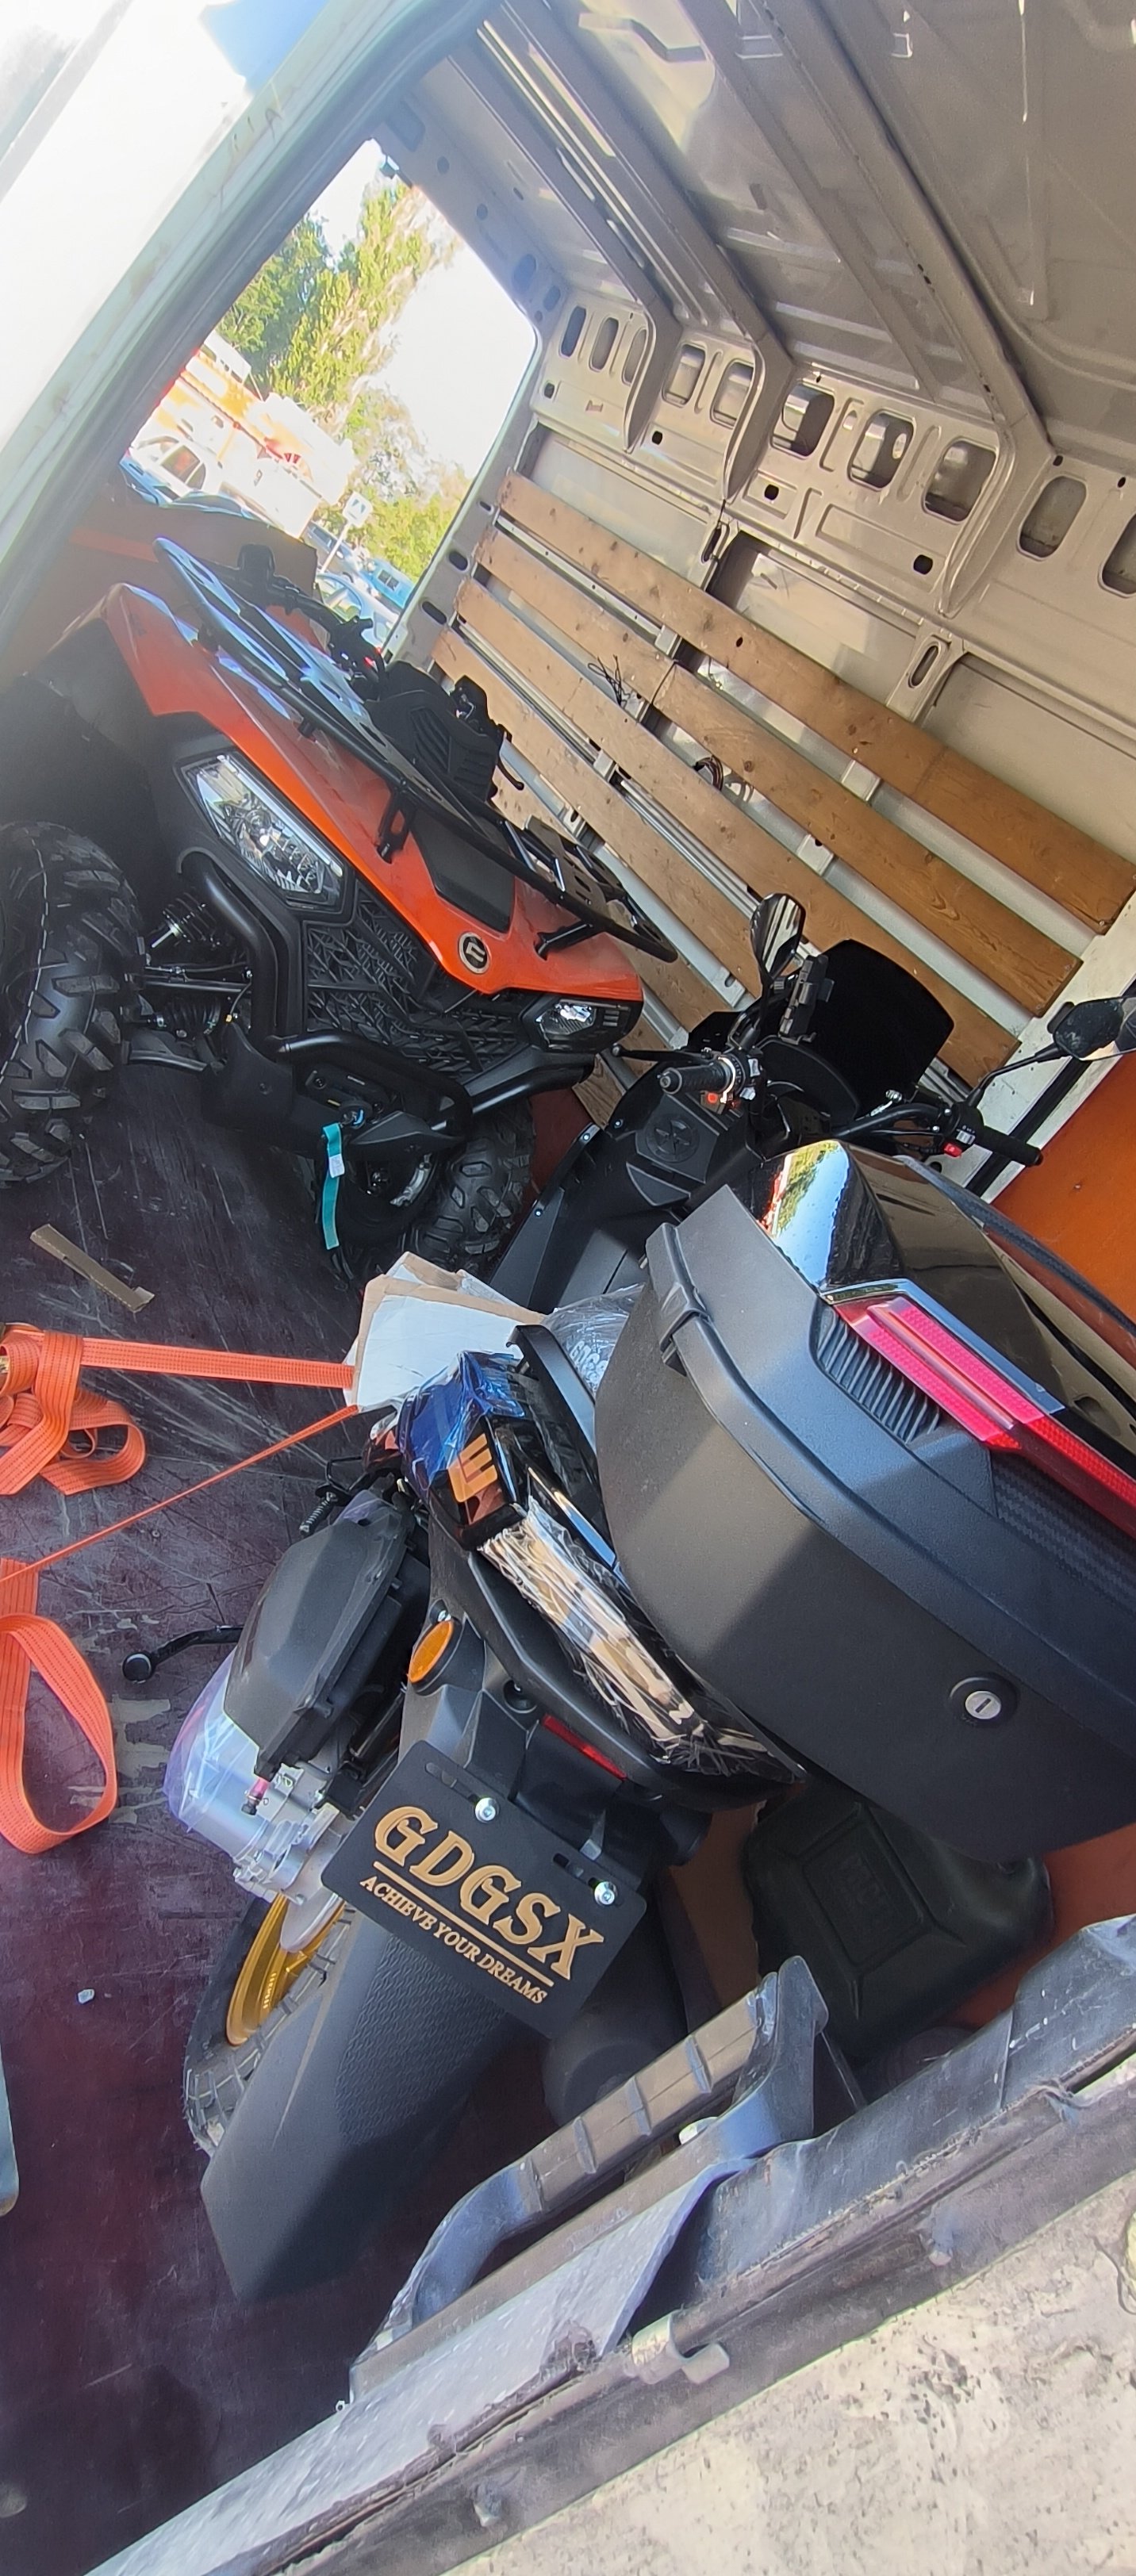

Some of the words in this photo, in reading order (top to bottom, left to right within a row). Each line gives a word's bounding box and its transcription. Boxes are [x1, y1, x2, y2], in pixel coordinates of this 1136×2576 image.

[359, 1876, 434, 1930] ACHIEVE
[433, 1925, 482, 1963] YOUR
[477, 1953, 548, 2004] DREAMS
[374, 1806, 604, 1980] GDGSX
